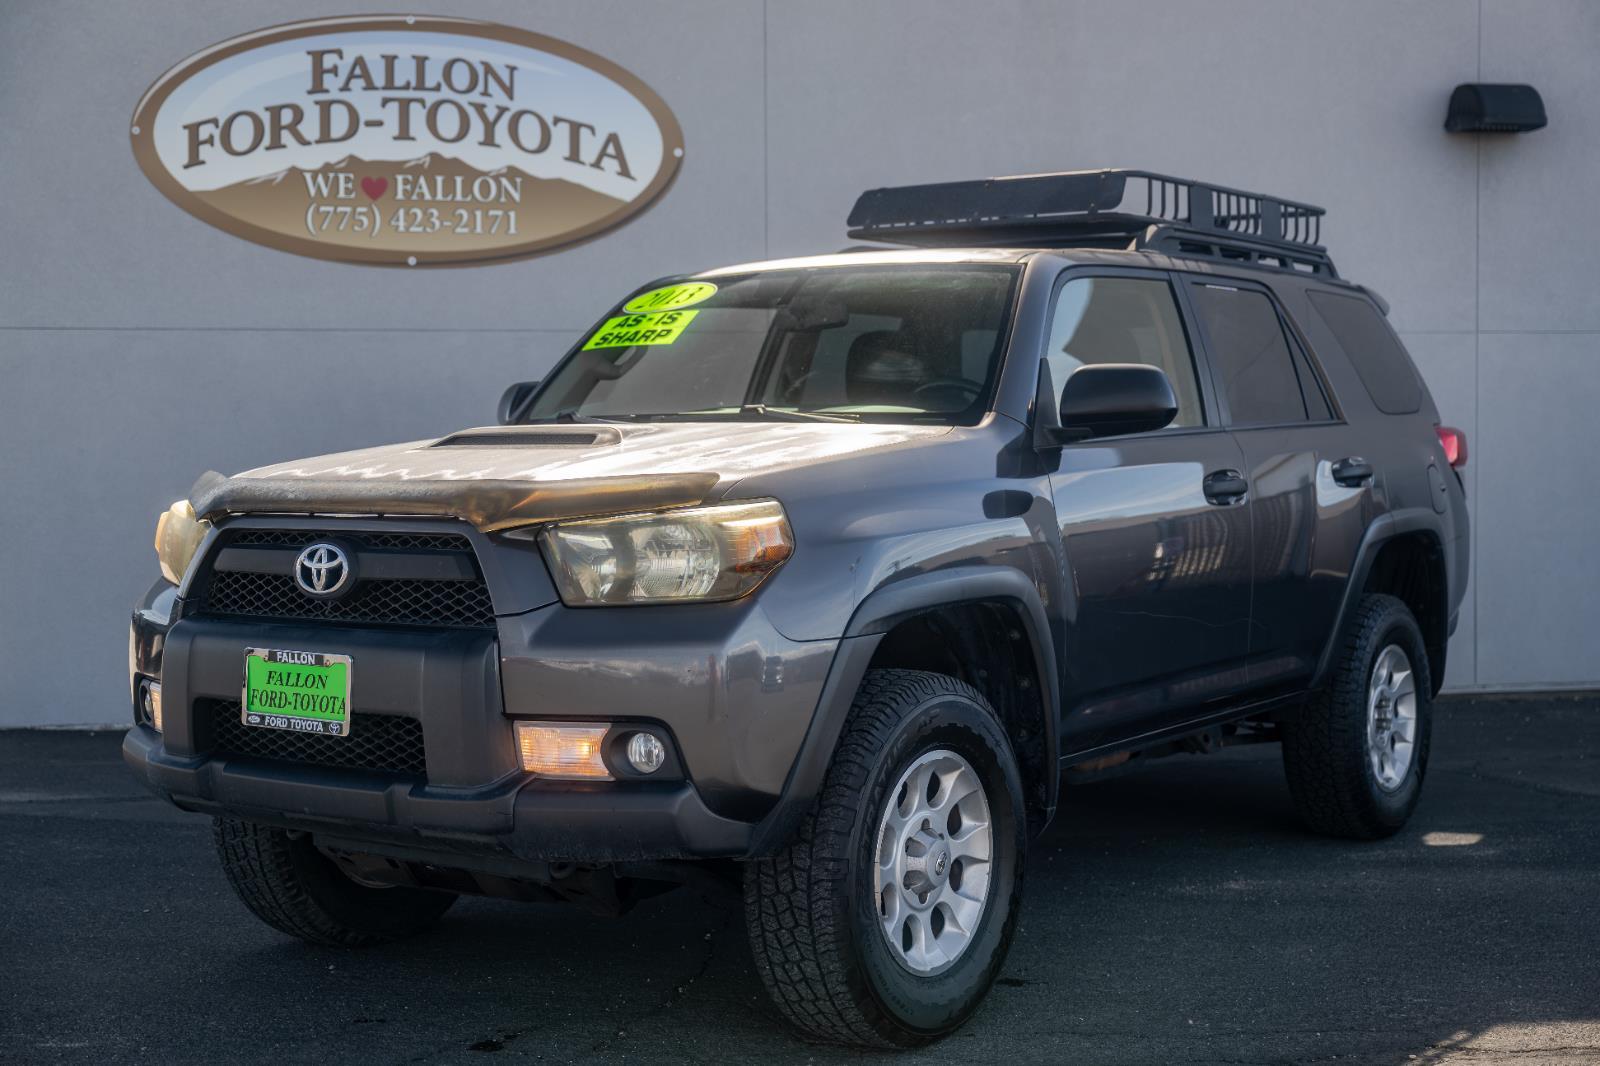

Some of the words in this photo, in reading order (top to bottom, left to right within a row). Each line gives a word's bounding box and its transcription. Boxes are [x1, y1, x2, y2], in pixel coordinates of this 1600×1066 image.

[306, 48, 518, 100] FALLON
[182, 97, 637, 182] FORD-TOYOTA
[303, 171, 355, 200] WE
[395, 174, 522, 203] FALLON
[306, 205, 382, 238] (775)
[391, 207, 519, 235] 423-2171
[594, 329, 673, 346] SHARP
[276, 651, 316, 665] FALLON
[266, 670, 329, 690] FALLON
[250, 688, 346, 715] FORD-TOYOTA
[264, 716, 288, 728] FORD
[290, 719, 324, 732] TOYOTA
